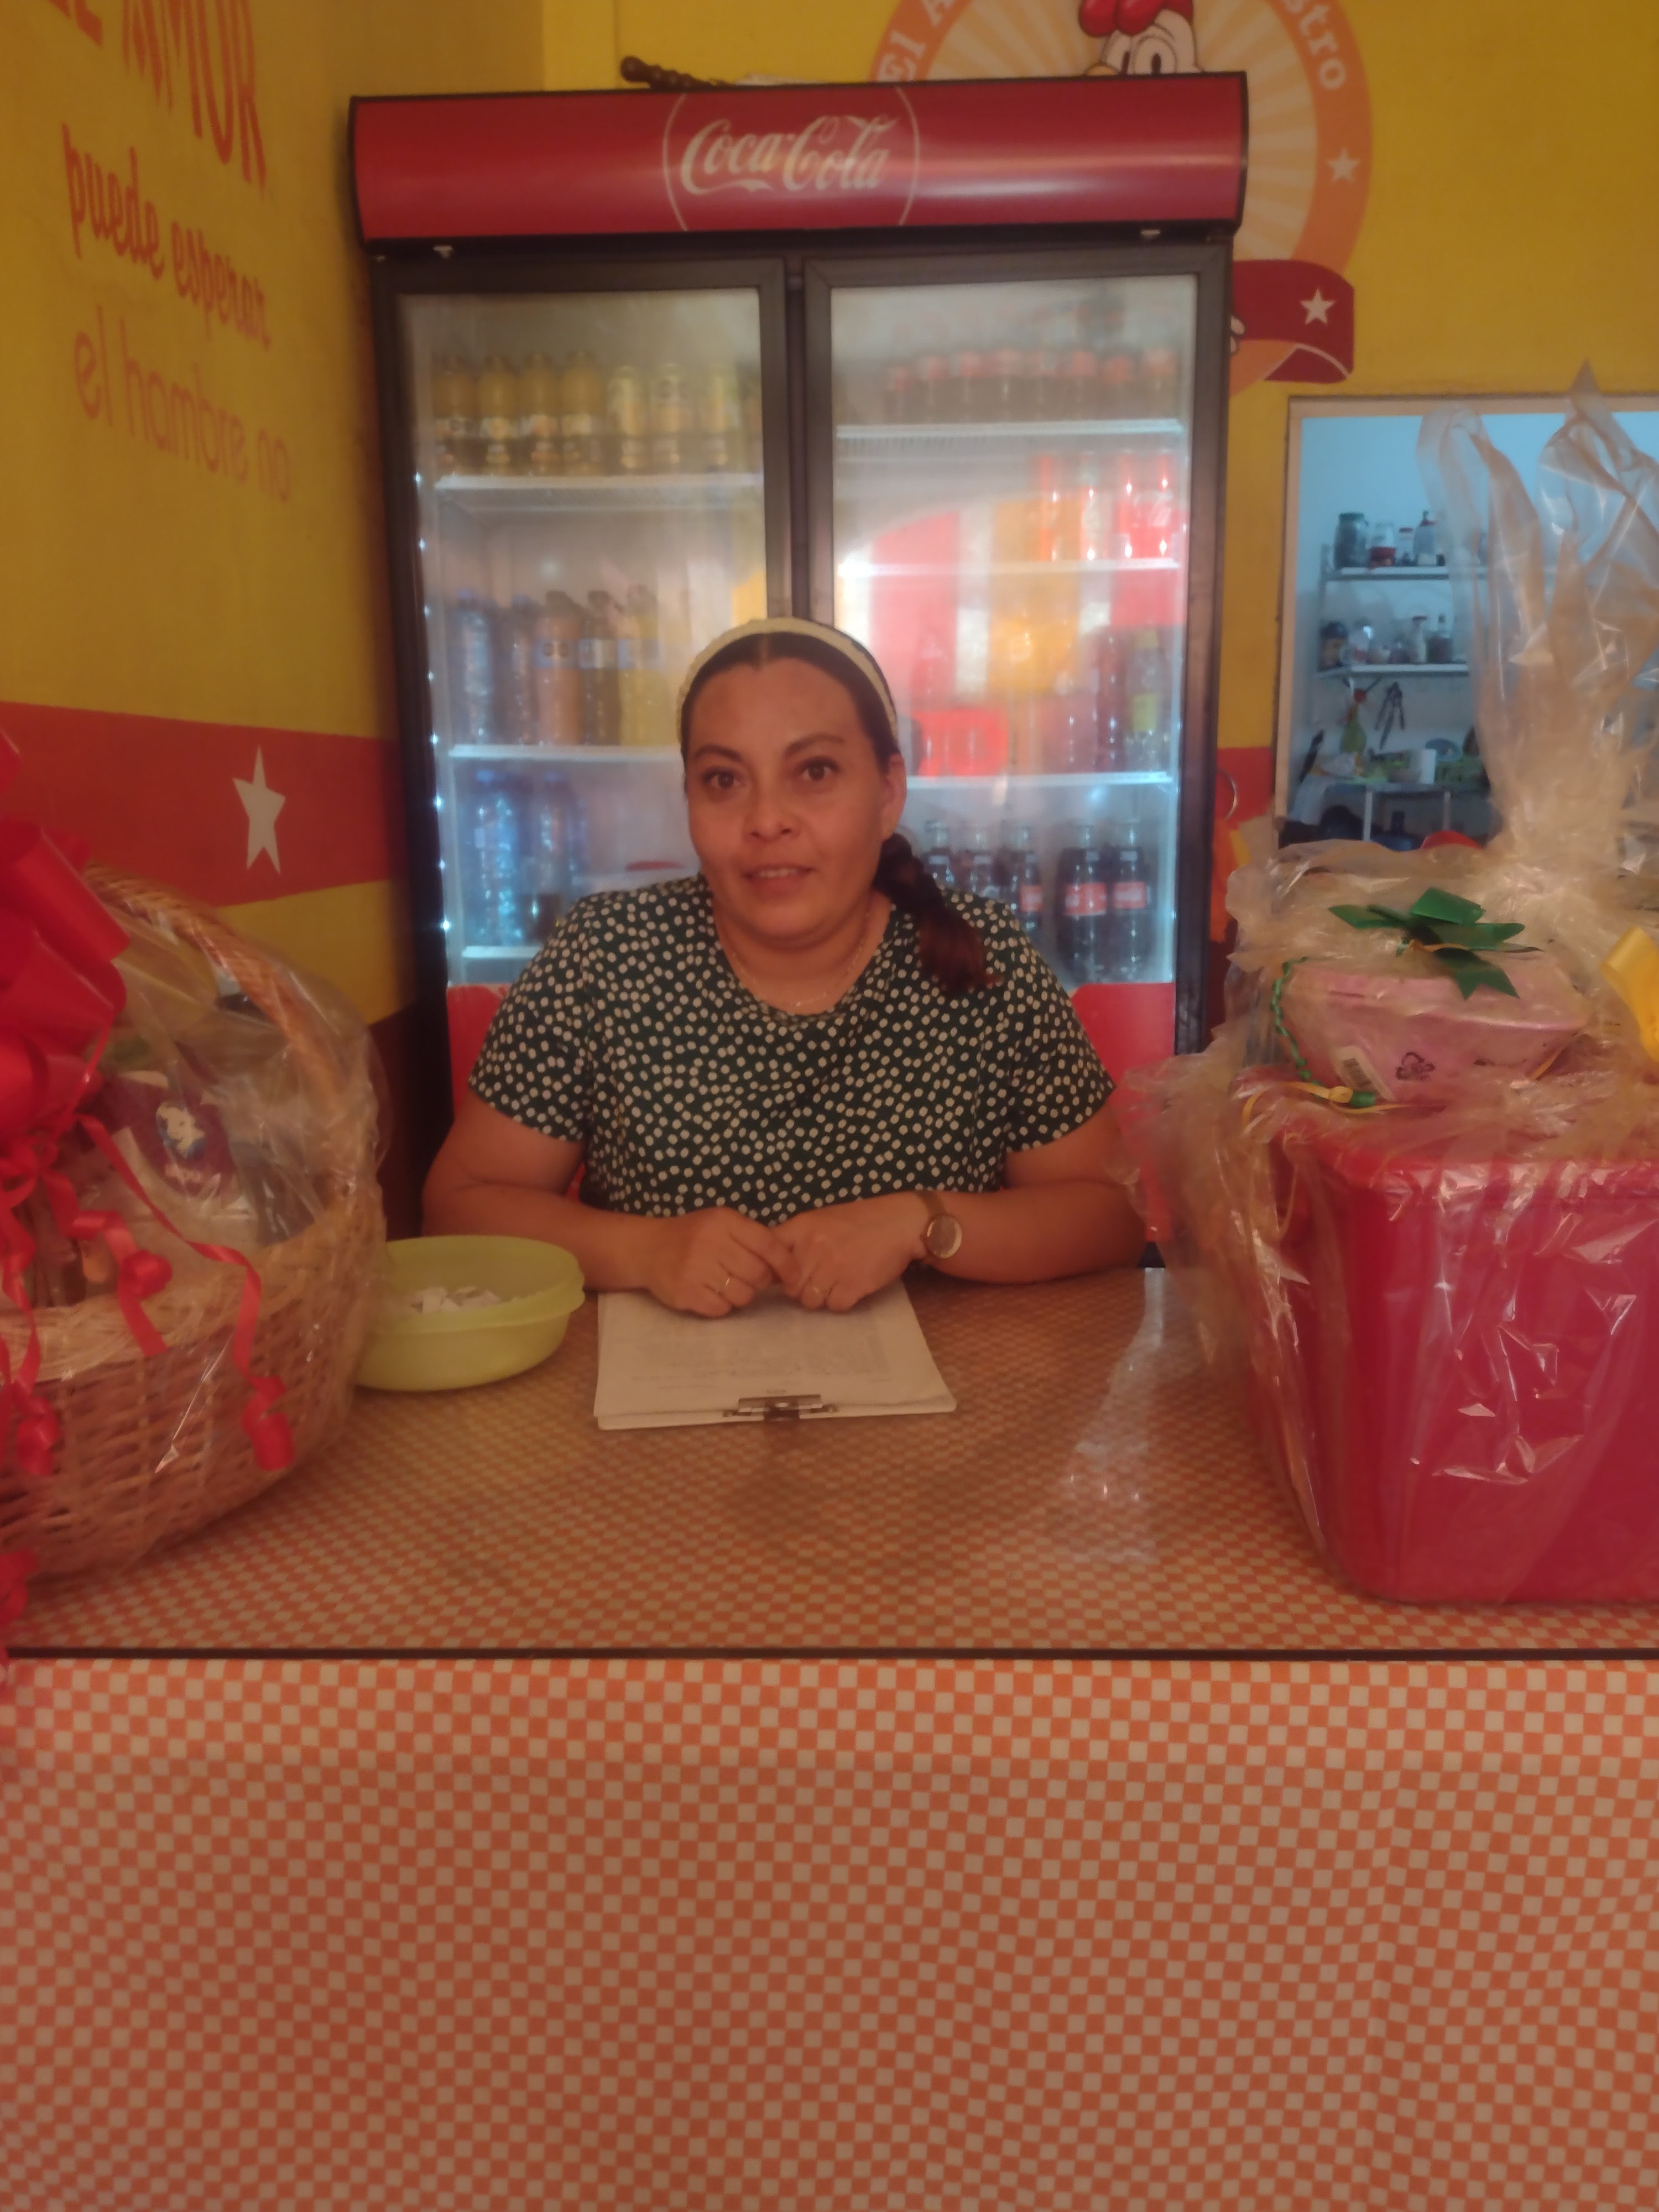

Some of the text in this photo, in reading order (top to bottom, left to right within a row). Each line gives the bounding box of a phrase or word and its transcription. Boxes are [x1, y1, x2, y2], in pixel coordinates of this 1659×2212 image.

[61, 121, 165, 281] puede
[74, 304, 114, 427] el
[257, 427, 292, 504] no
